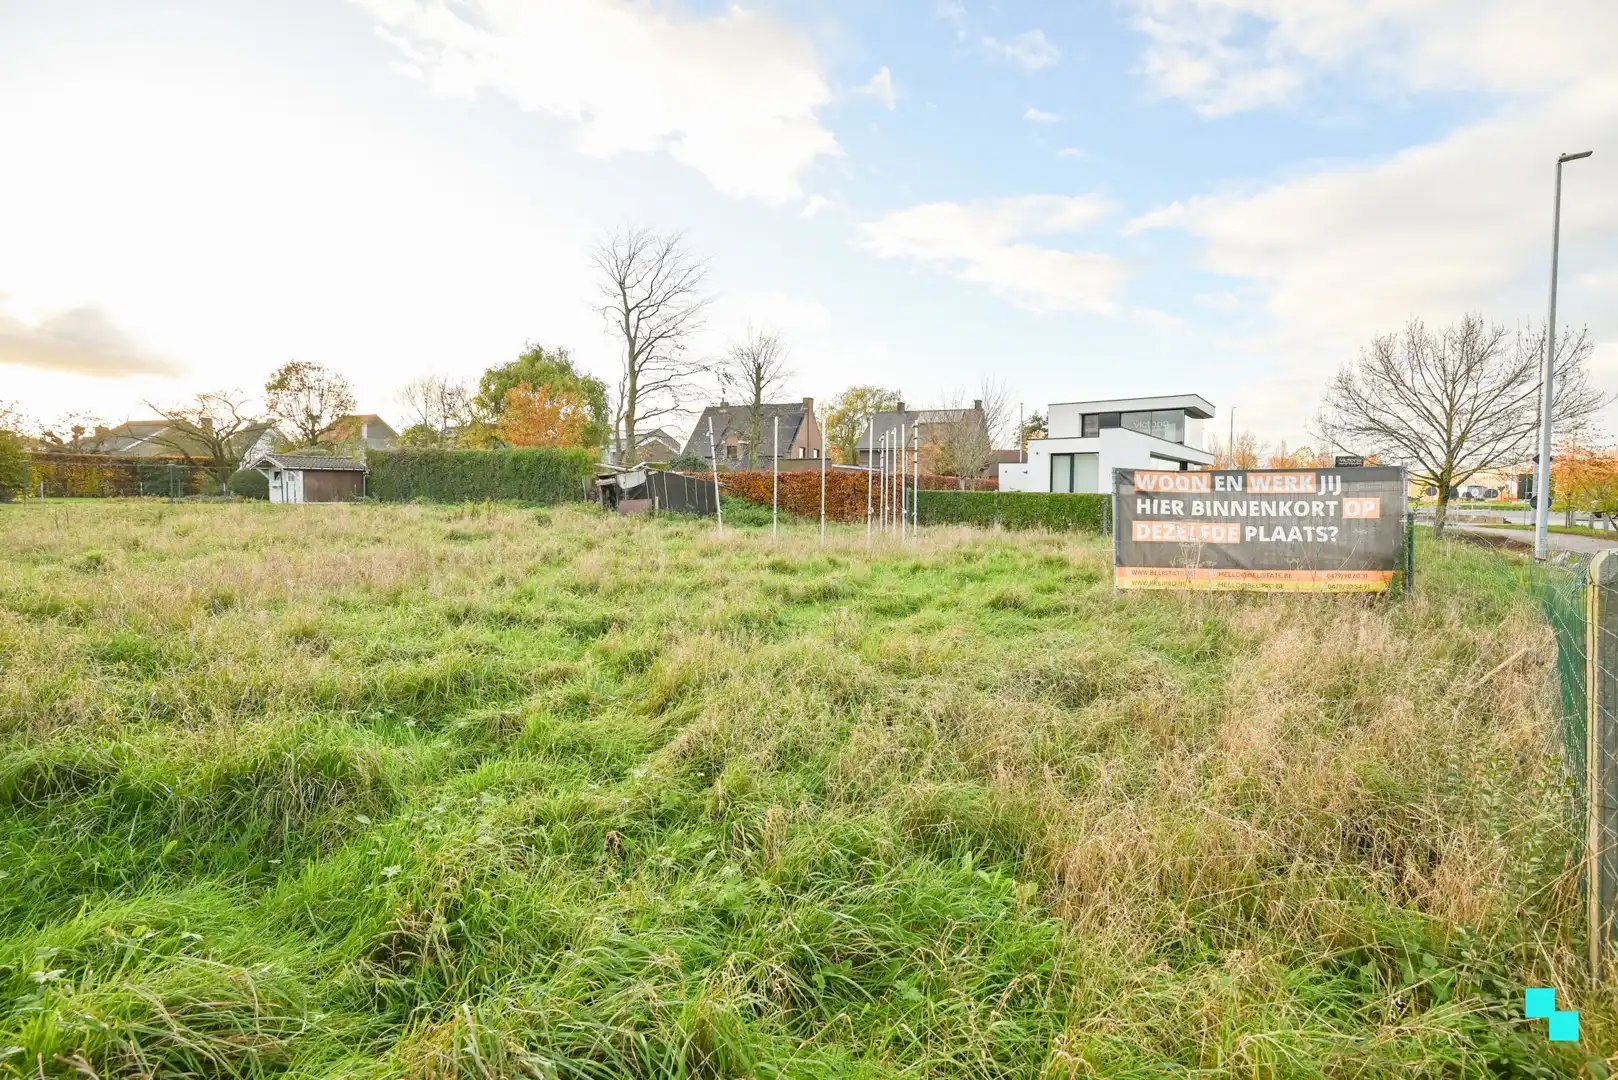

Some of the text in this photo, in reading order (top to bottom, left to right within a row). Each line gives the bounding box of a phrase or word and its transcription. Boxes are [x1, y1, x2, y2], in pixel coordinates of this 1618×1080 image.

[1136, 474, 1341, 496] WOON EN WERK JIJ
[1136, 498, 1376, 517] HIER BINNENKORT OP
[1135, 523, 1339, 543] DEZELFDE PLAATS?
